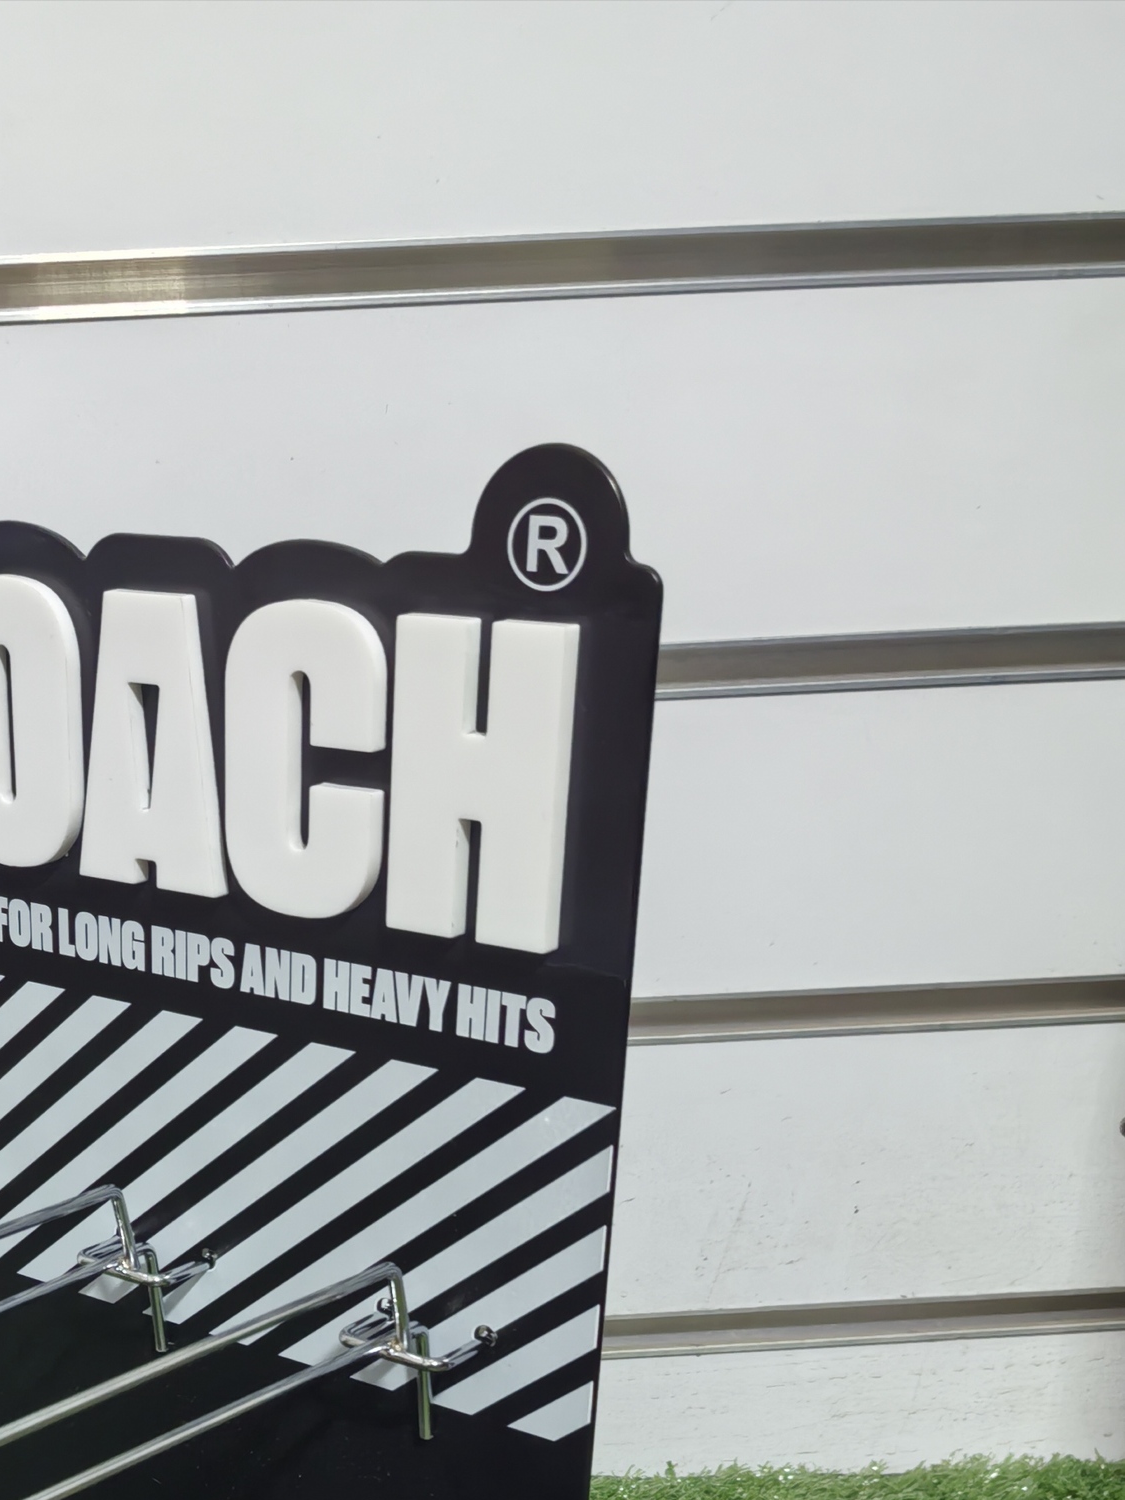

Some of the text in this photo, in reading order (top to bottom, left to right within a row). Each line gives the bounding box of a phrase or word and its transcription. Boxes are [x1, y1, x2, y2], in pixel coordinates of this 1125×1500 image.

[58, 909, 146, 972] LONG
[151, 924, 236, 990] RIPS
[240, 943, 316, 1007] AND
[322, 958, 449, 1034] HEAVY
[456, 979, 556, 1055] HITS
